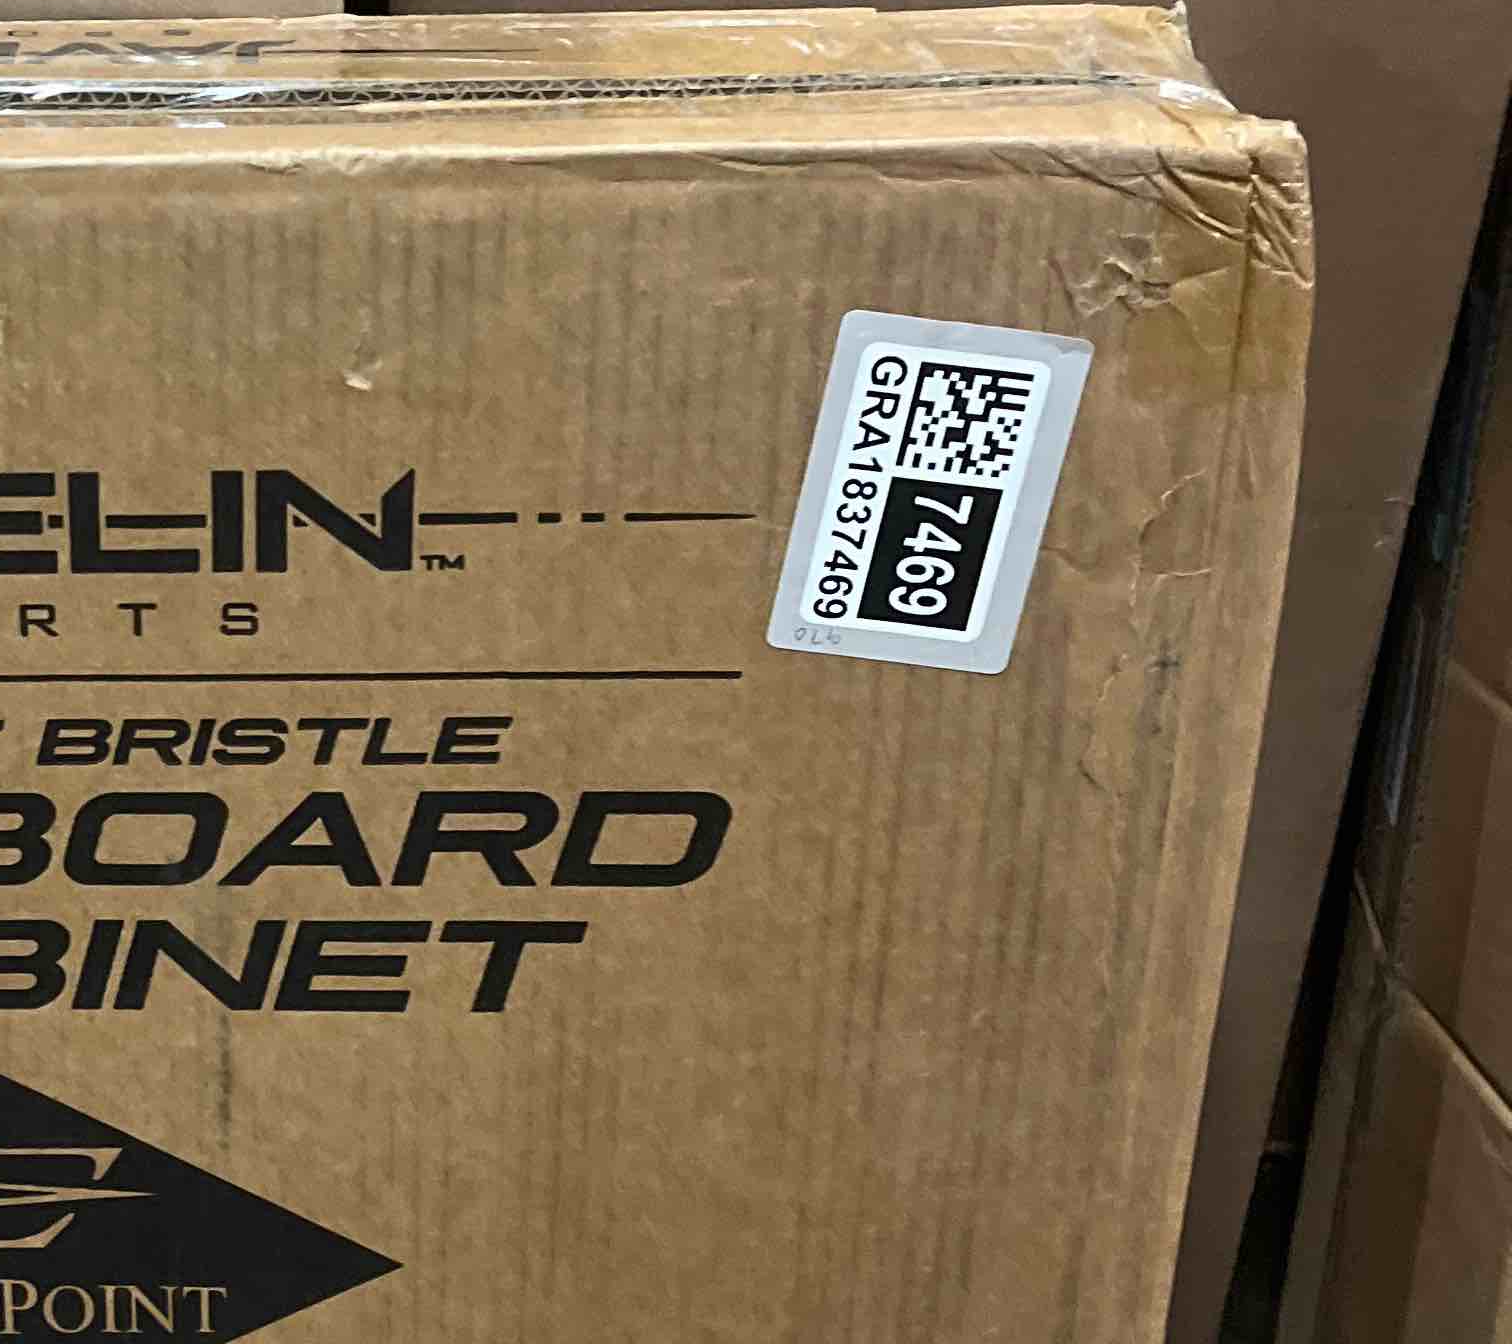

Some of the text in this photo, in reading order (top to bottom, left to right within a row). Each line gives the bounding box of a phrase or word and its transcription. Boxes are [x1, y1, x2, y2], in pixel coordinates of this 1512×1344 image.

[812, 355, 908, 619] GRA1837469
[888, 495, 975, 616] 7469
[36, 717, 513, 765] BRISTLE
